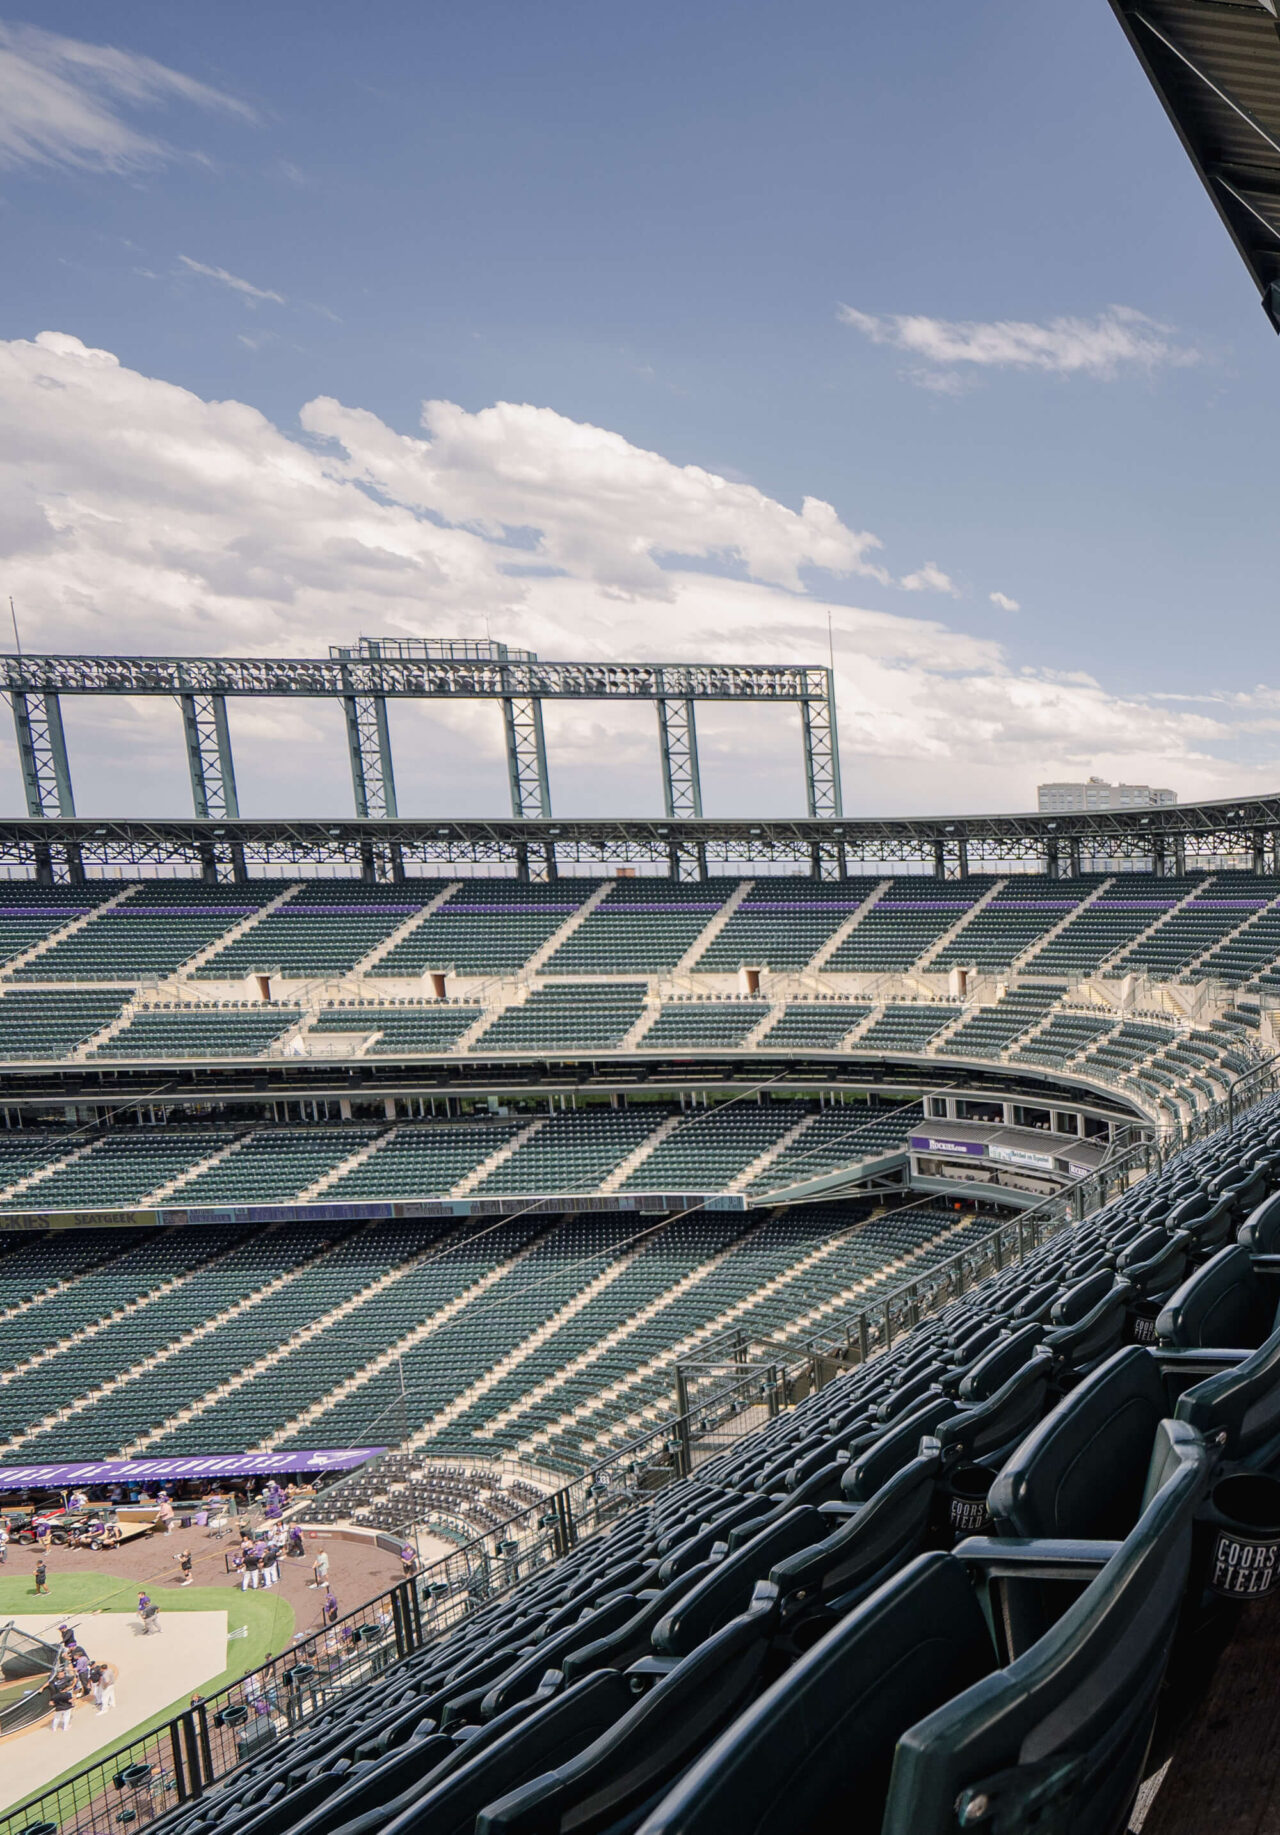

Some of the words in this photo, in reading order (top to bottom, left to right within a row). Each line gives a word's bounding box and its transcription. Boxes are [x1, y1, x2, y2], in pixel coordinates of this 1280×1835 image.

[74, 1212, 136, 1226] SEATGEEK
[66, 1465, 112, 1478] 30
[108, 1454, 297, 1476] CELEBRATING
[951, 1500, 984, 1516] COORS
[950, 1512, 982, 1529] FIELD
[1218, 1538, 1278, 1568] COORS
[1212, 1560, 1273, 1592] FIELD
